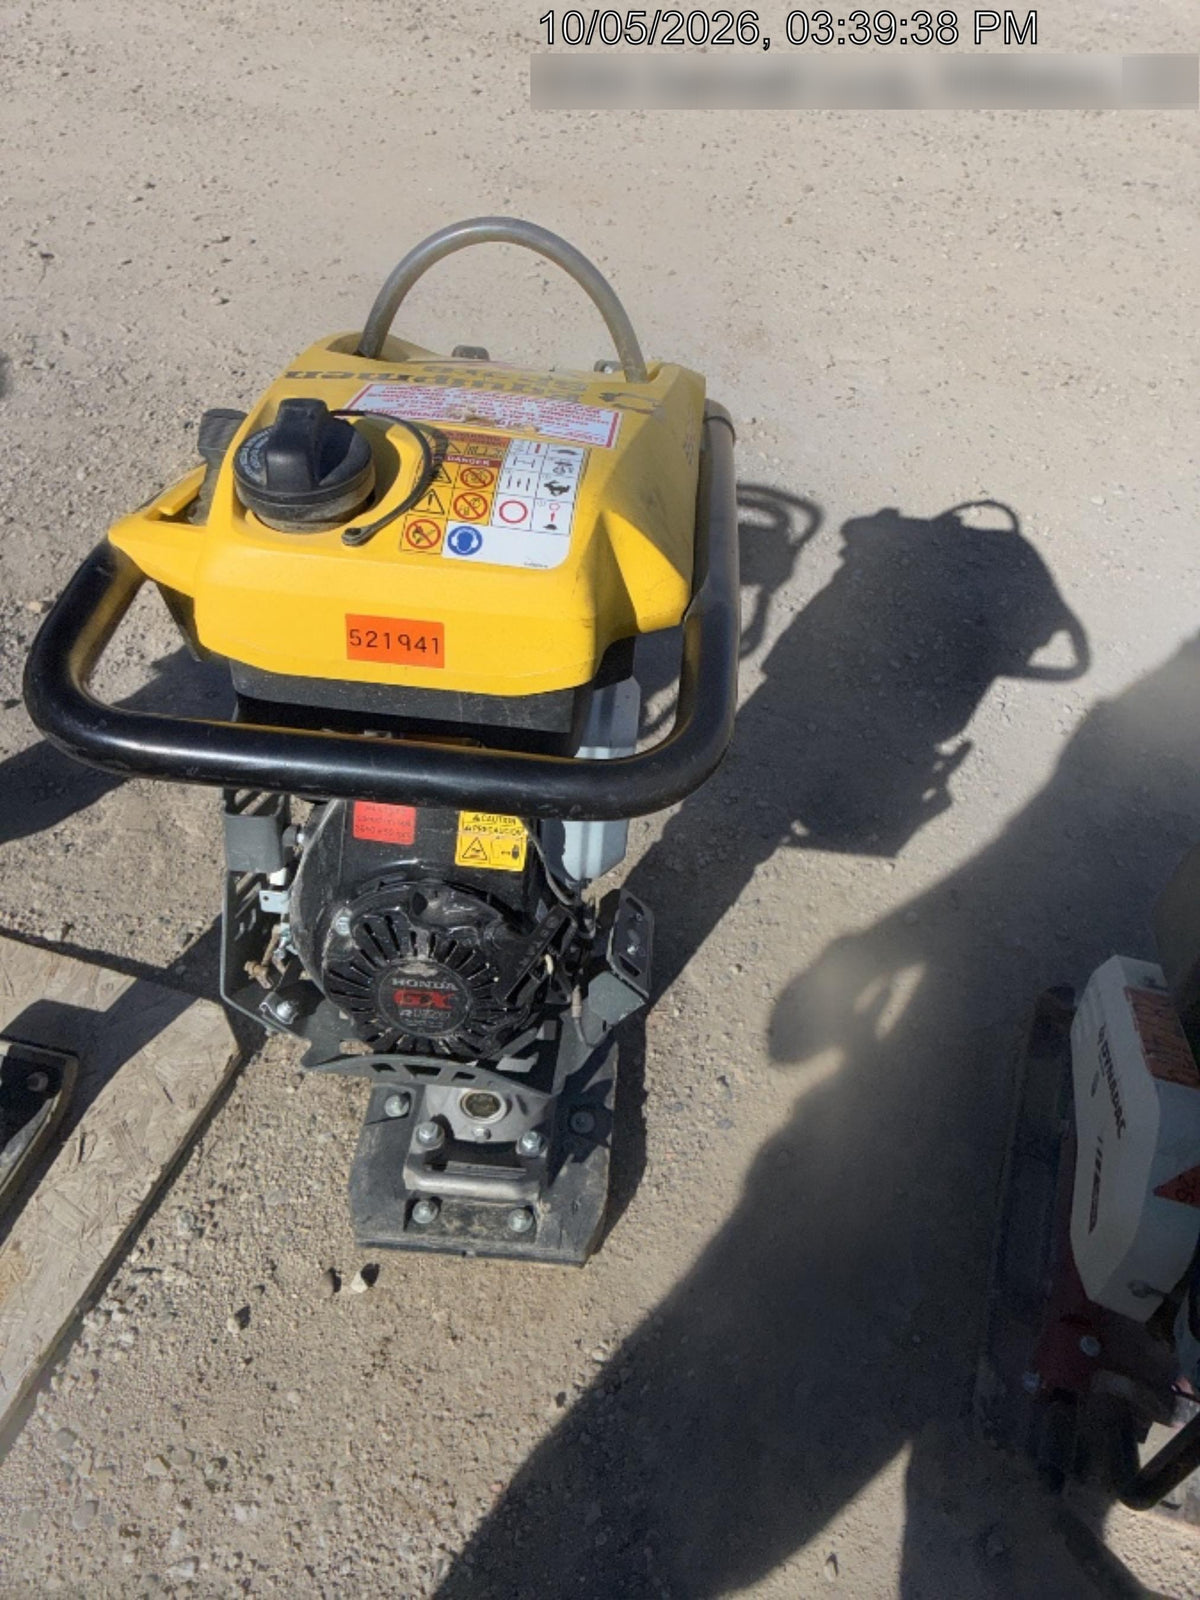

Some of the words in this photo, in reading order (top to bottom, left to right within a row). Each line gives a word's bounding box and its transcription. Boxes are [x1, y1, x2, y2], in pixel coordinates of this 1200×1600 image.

[447, 455, 490, 466] DANGER
[349, 628, 439, 655] 521941
[391, 977, 458, 991] HONDA
[392, 989, 455, 1010] GX
